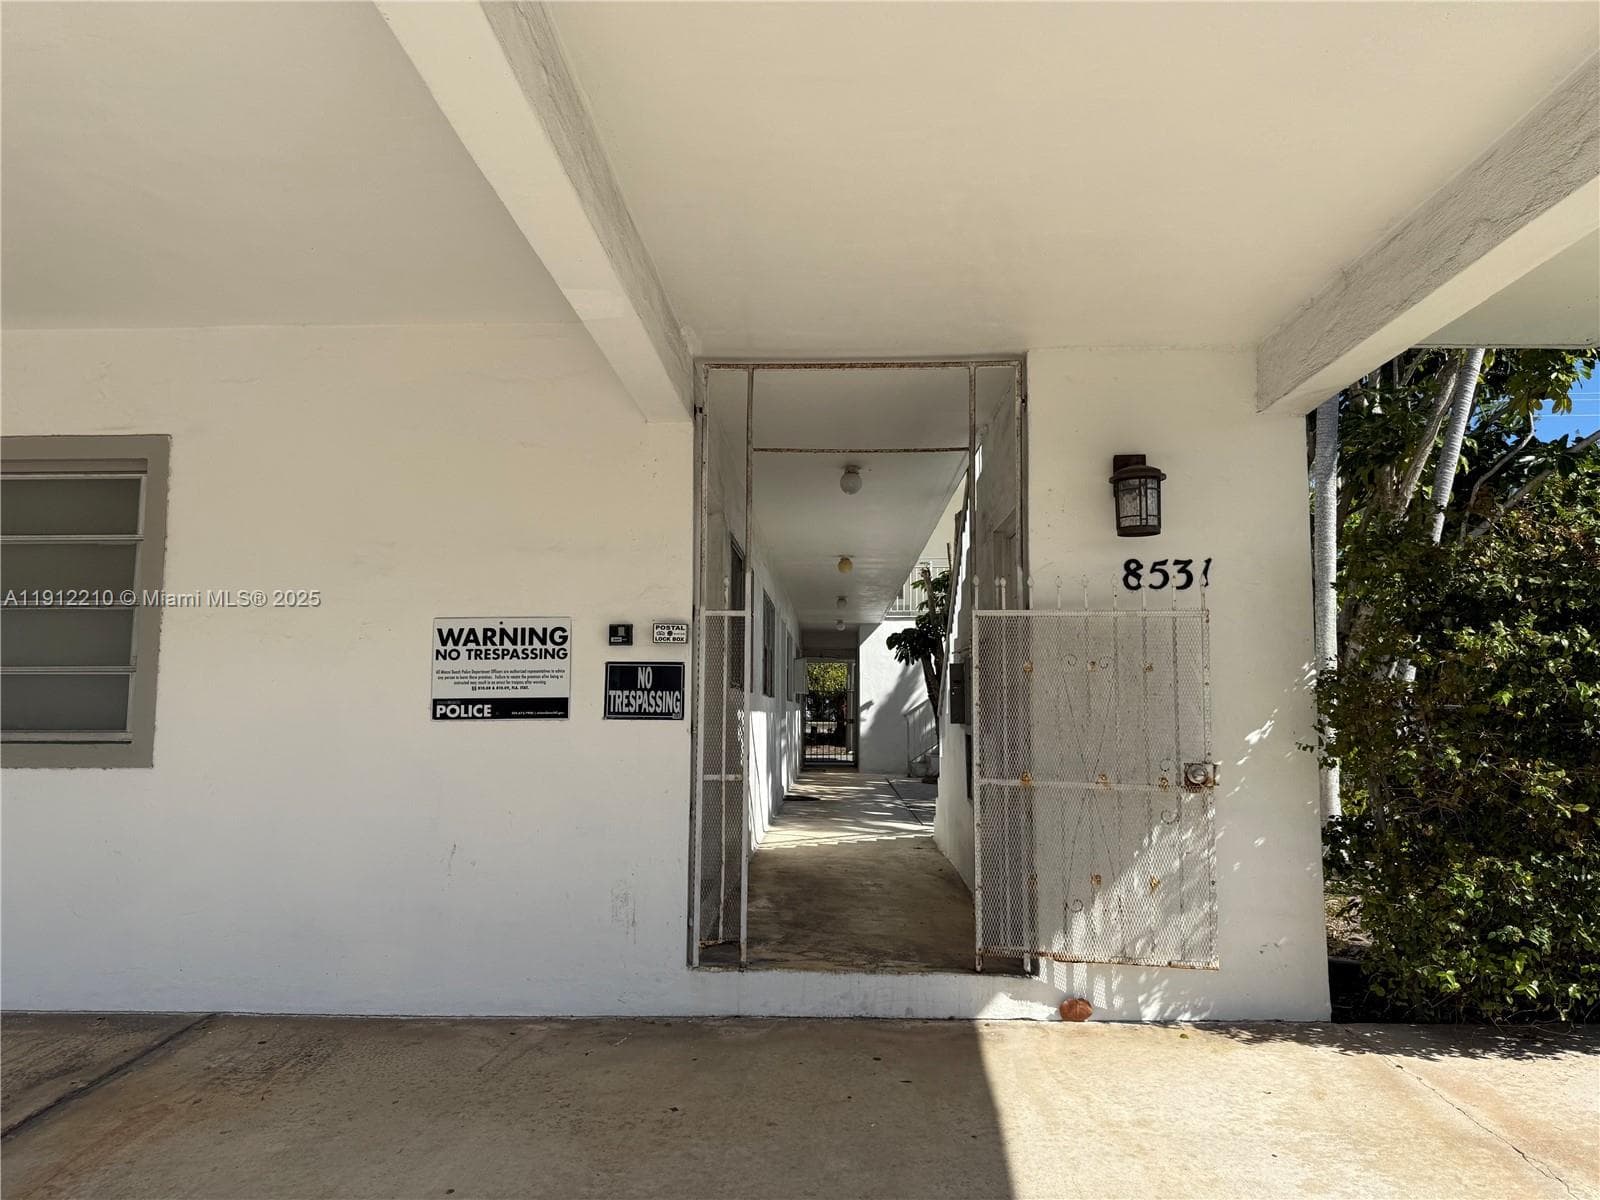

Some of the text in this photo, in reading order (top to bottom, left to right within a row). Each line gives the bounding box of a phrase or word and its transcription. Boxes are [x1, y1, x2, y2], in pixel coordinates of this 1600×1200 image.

[1122, 557, 1212, 591] 8531
[436, 626, 569, 647] WARNING
[435, 647, 569, 661] NO TRESPASSING
[637, 666, 653, 689] NO
[436, 704, 492, 718] POLICE
[608, 690, 681, 713] TRESPASSING
